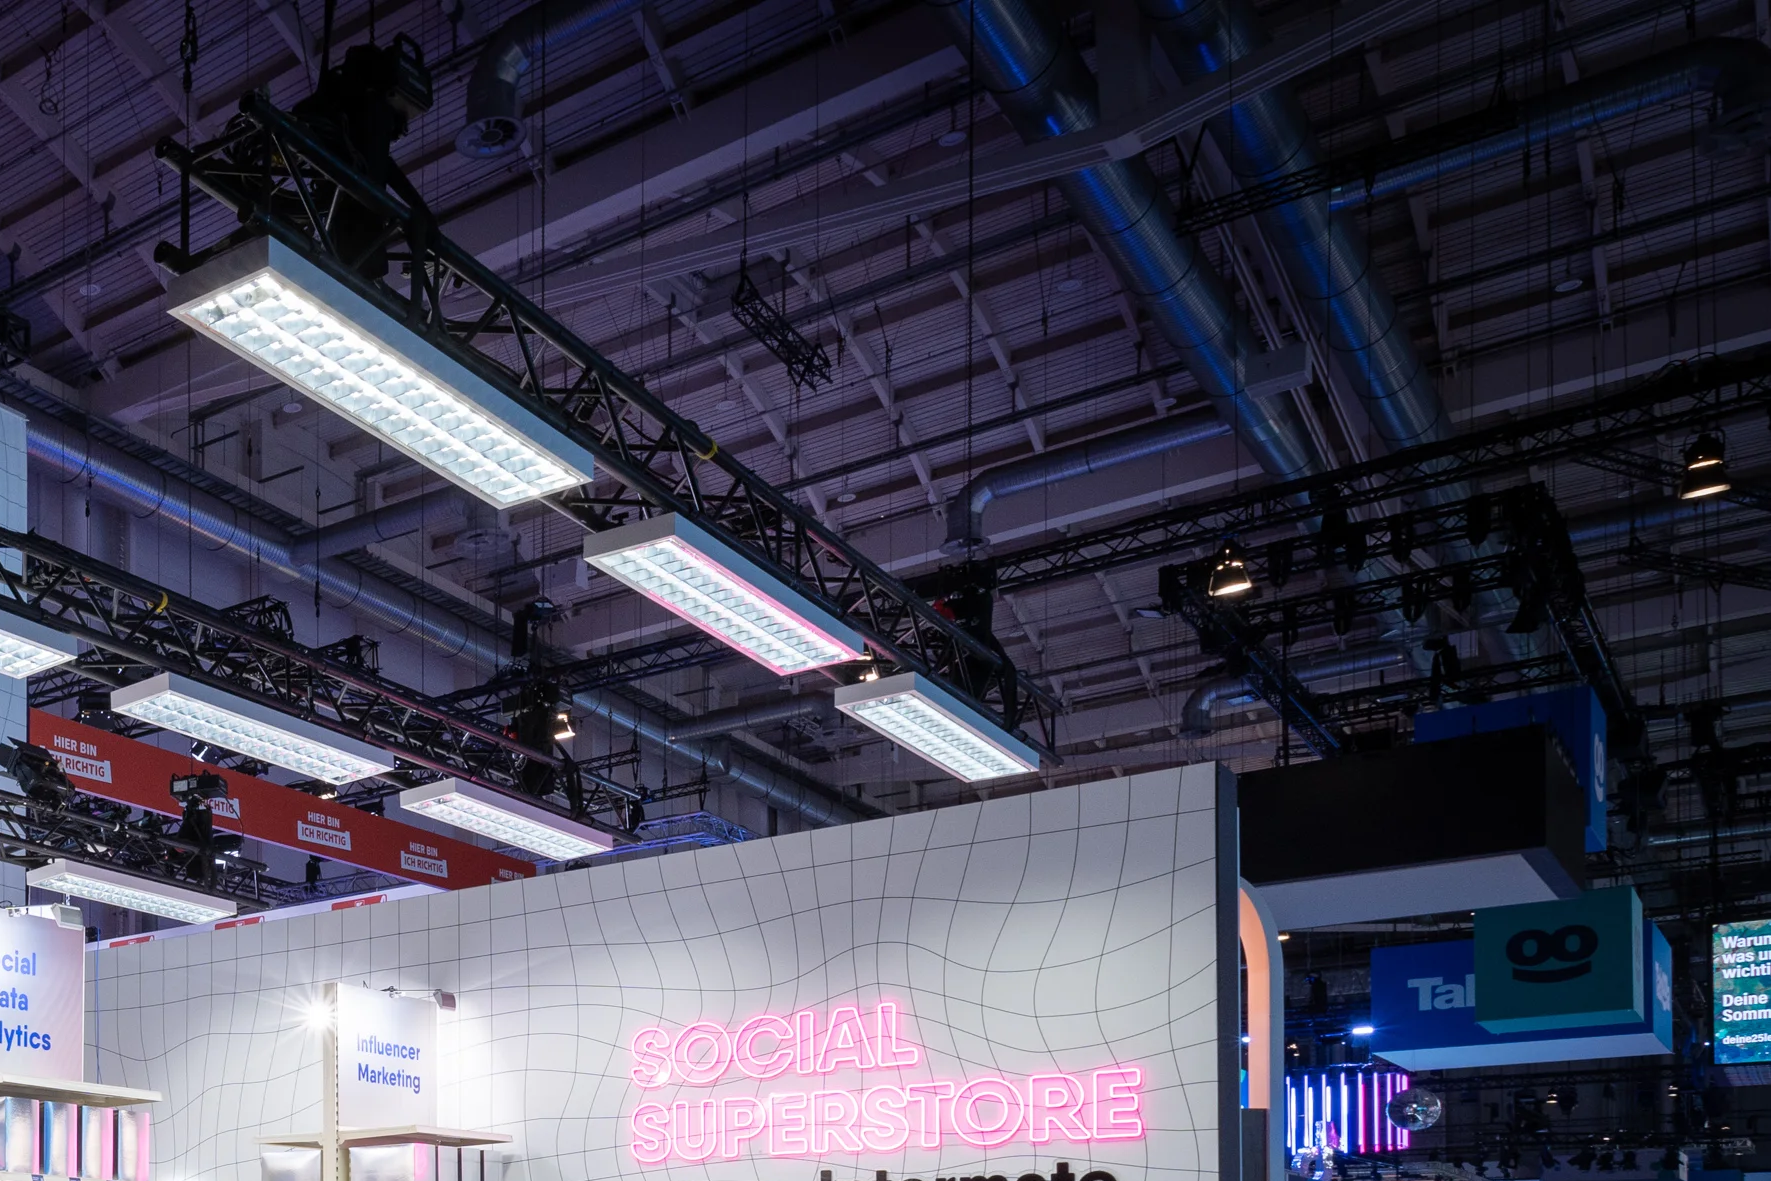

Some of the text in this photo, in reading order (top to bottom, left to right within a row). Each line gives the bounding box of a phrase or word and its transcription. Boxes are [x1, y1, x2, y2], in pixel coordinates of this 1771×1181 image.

[53, 735, 78, 752] HIER
[80, 743, 97, 757] BIN
[65, 757, 105, 777] RICHTIG
[307, 811, 340, 828] HIER BIN
[301, 826, 346, 846] ICH RICHTIG
[409, 842, 438, 857] HIER BIN
[404, 856, 444, 873] ICH RICHTIG
[499, 868, 513, 879] HIER
[1722, 950, 1755, 964] was
[1722, 993, 1769, 1007] Deine
[357, 1033, 421, 1060] Influencer
[629, 1001, 918, 1087] SOCIAL
[358, 1062, 421, 1094] Marketing
[629, 1067, 1145, 1162] SUPERSTORE
